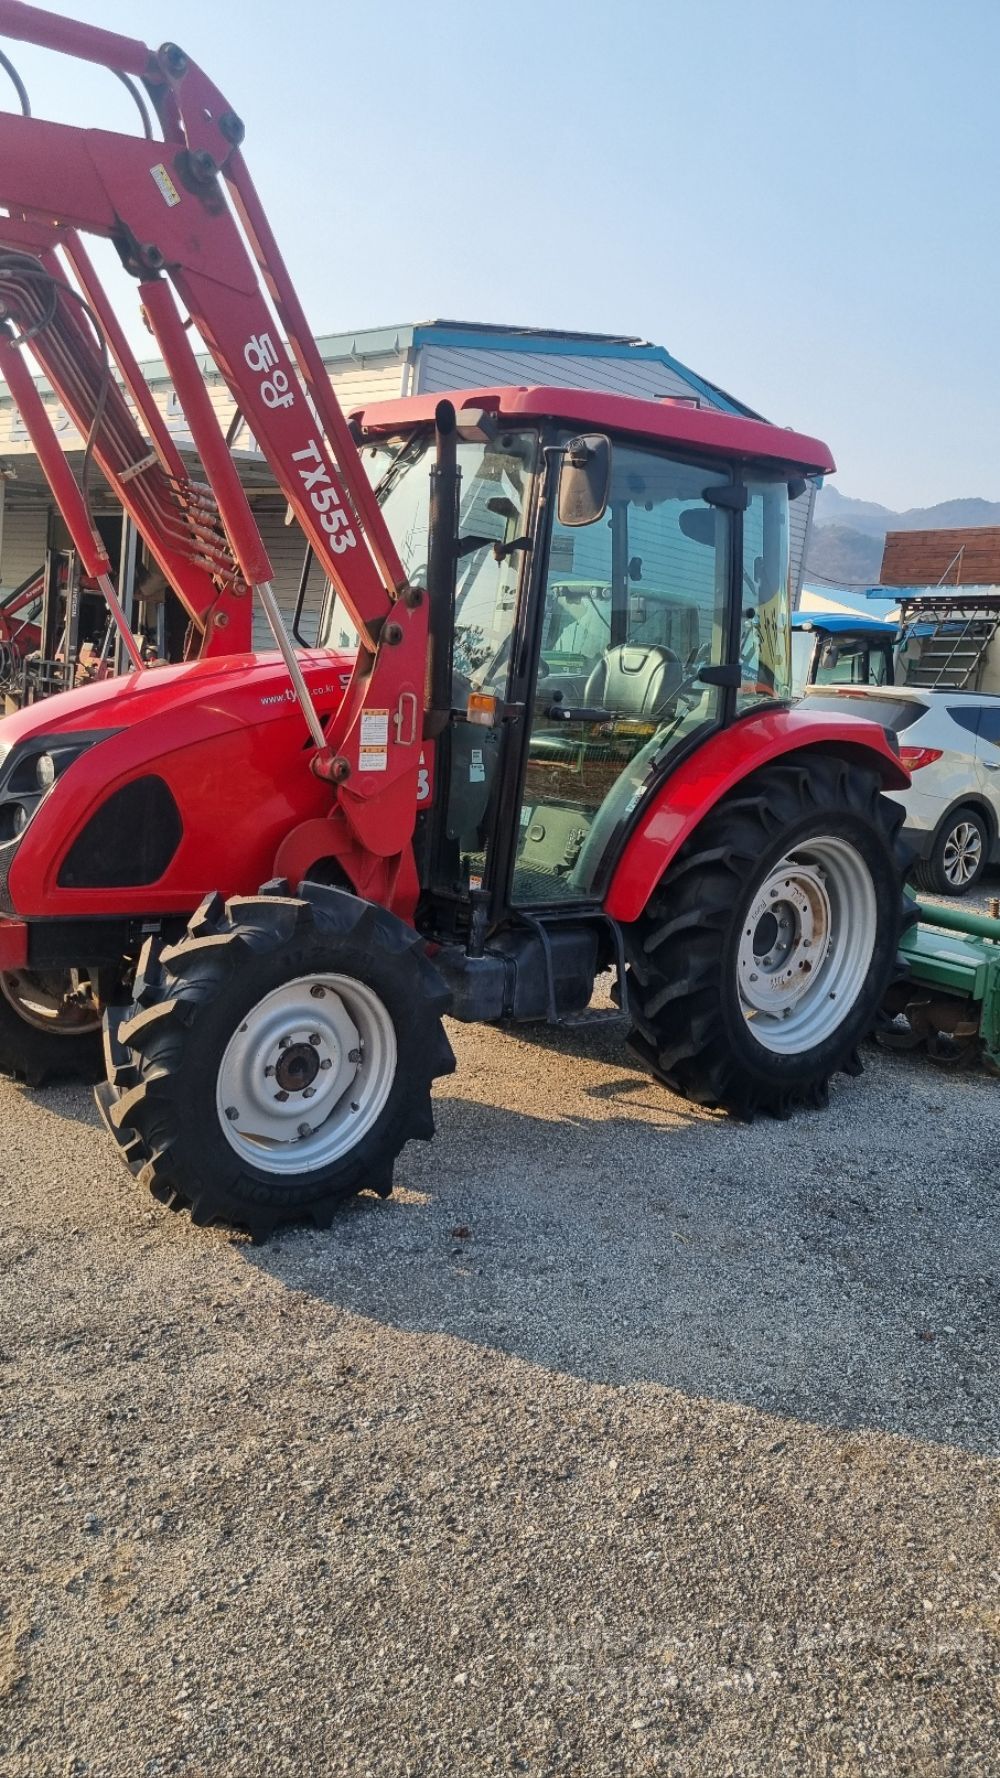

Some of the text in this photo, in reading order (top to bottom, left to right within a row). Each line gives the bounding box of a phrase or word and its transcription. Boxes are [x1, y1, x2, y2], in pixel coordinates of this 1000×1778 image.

[243, 332, 294, 409] 동양
[291, 439, 357, 556] TX553
[260, 684, 334, 706] www.ty.co.kr
